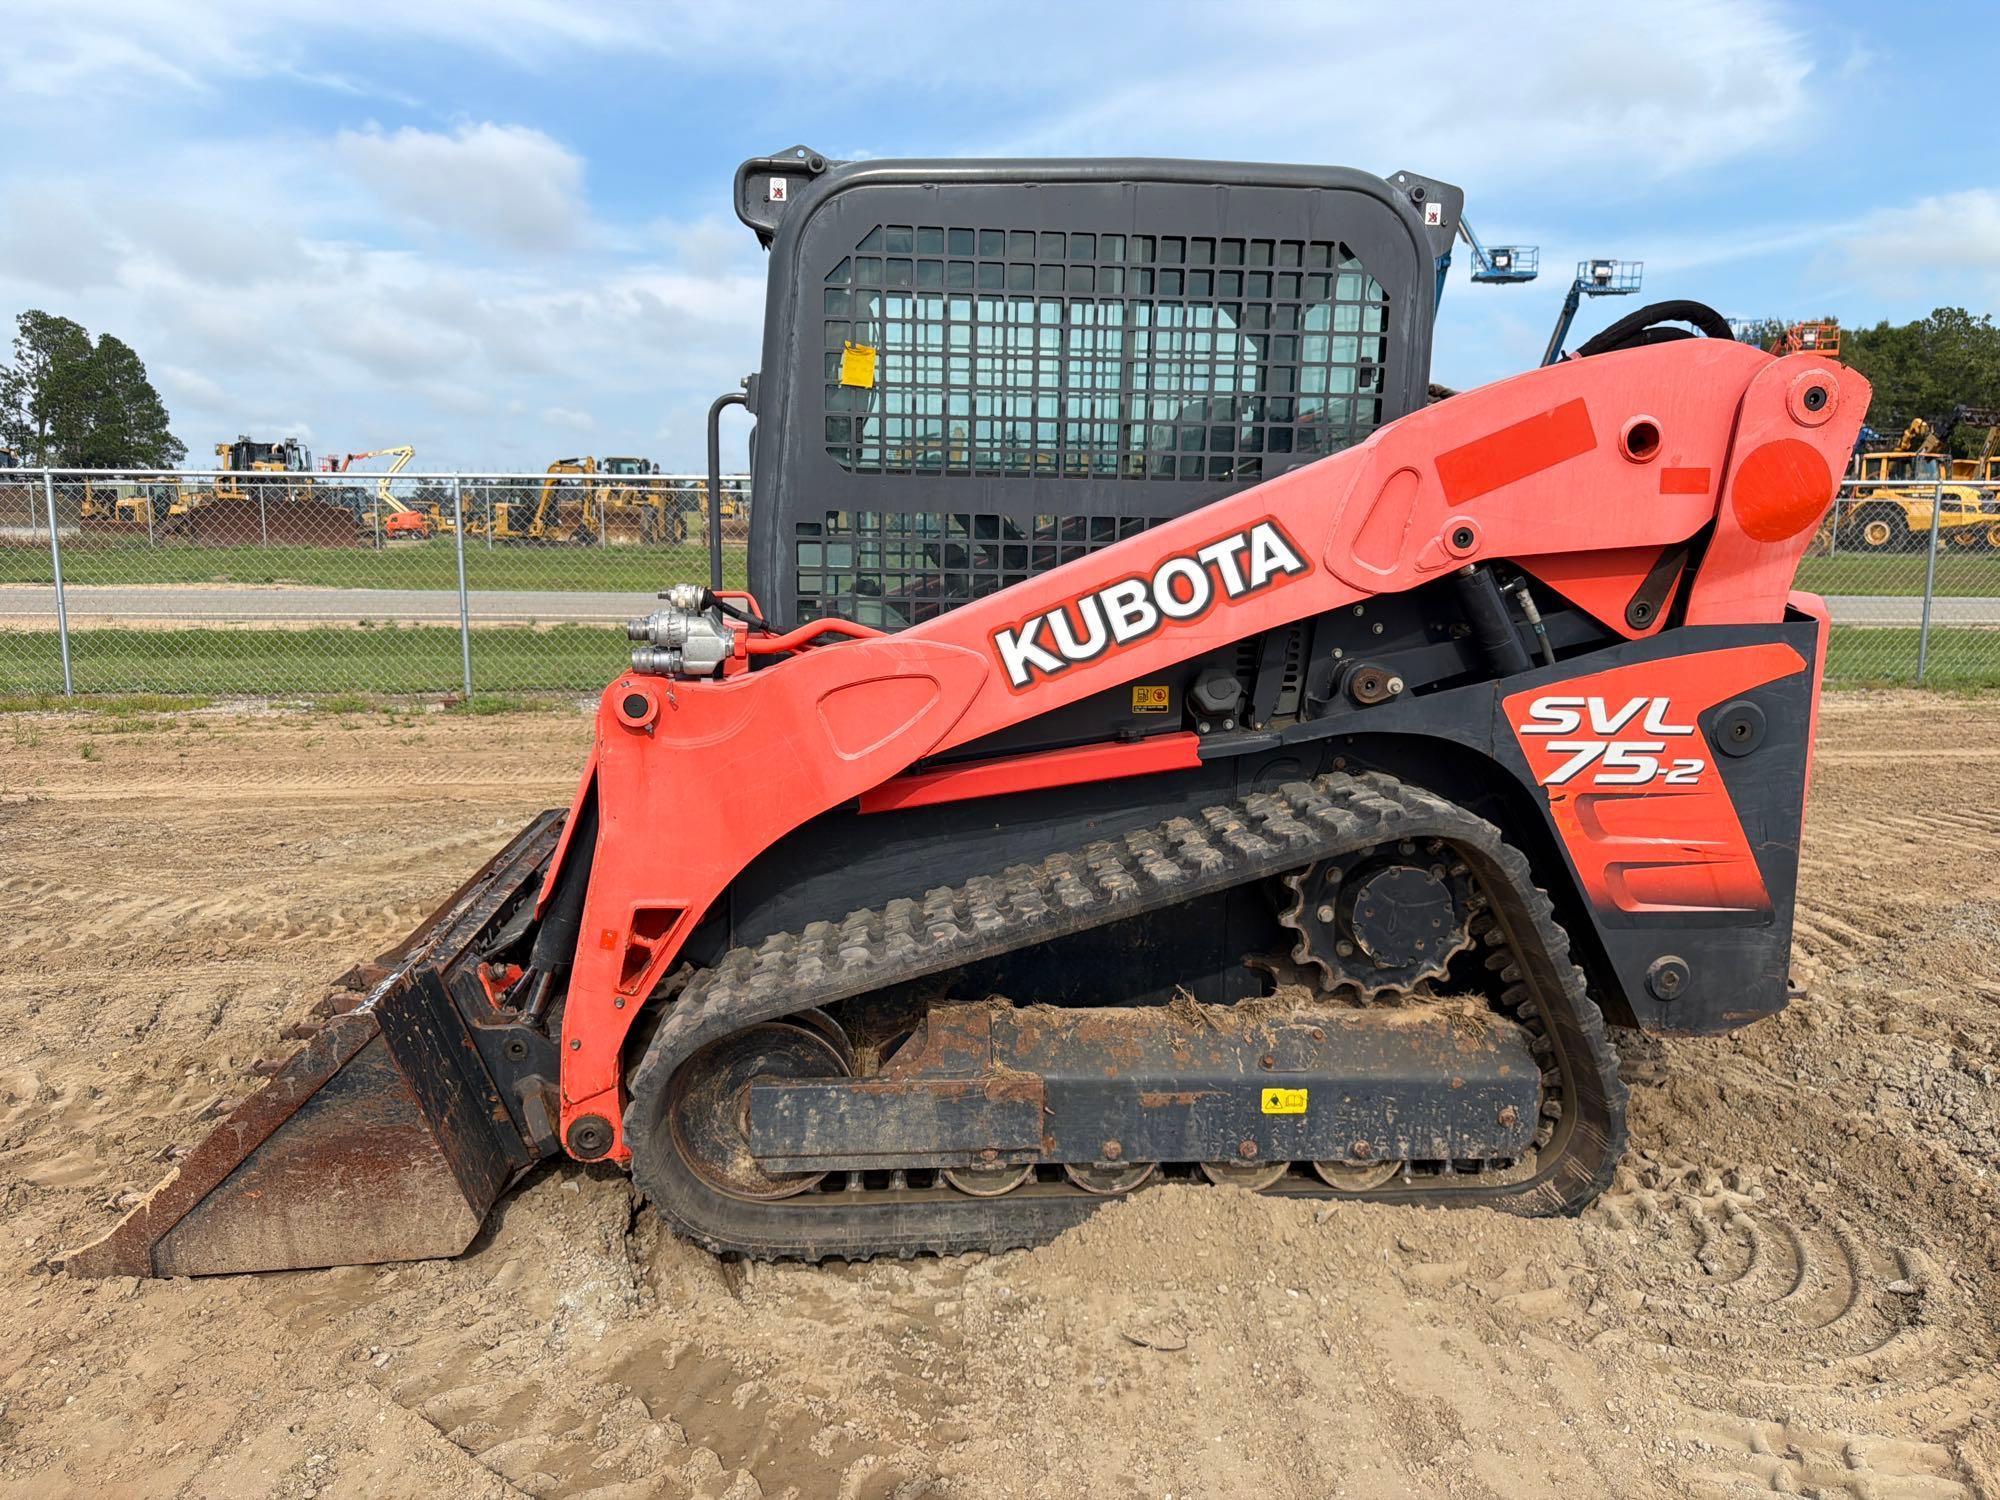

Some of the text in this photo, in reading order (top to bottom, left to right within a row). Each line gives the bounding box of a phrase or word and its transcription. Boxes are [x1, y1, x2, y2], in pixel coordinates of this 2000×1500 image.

[994, 522, 1302, 687] KUBOTA
[1519, 697, 1695, 735] SVL
[1542, 741, 1705, 785] 75-2
